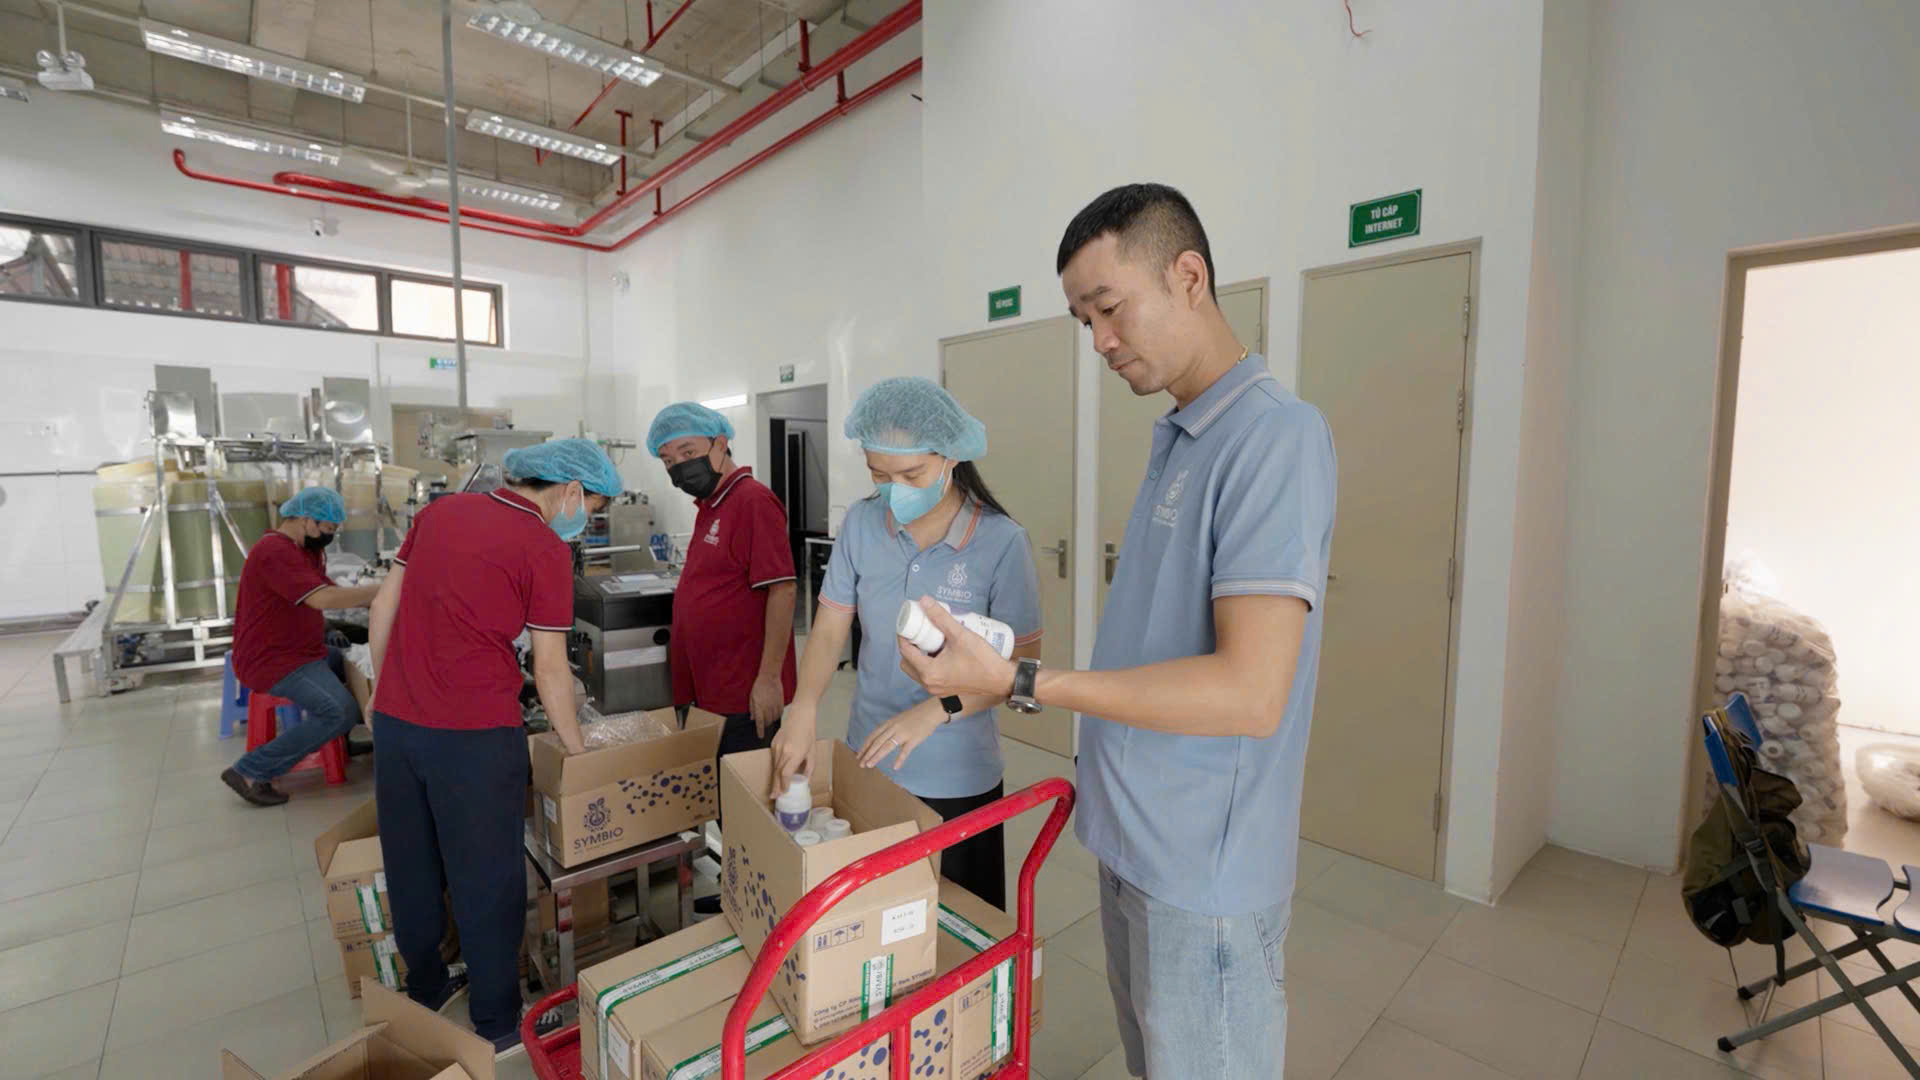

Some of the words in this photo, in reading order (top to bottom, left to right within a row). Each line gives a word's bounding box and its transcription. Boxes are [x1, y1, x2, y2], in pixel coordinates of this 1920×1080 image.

[1365, 217, 1403, 234] INTERNET
[936, 585, 972, 598] SYMBIO
[574, 827, 624, 850] SYMBIO
